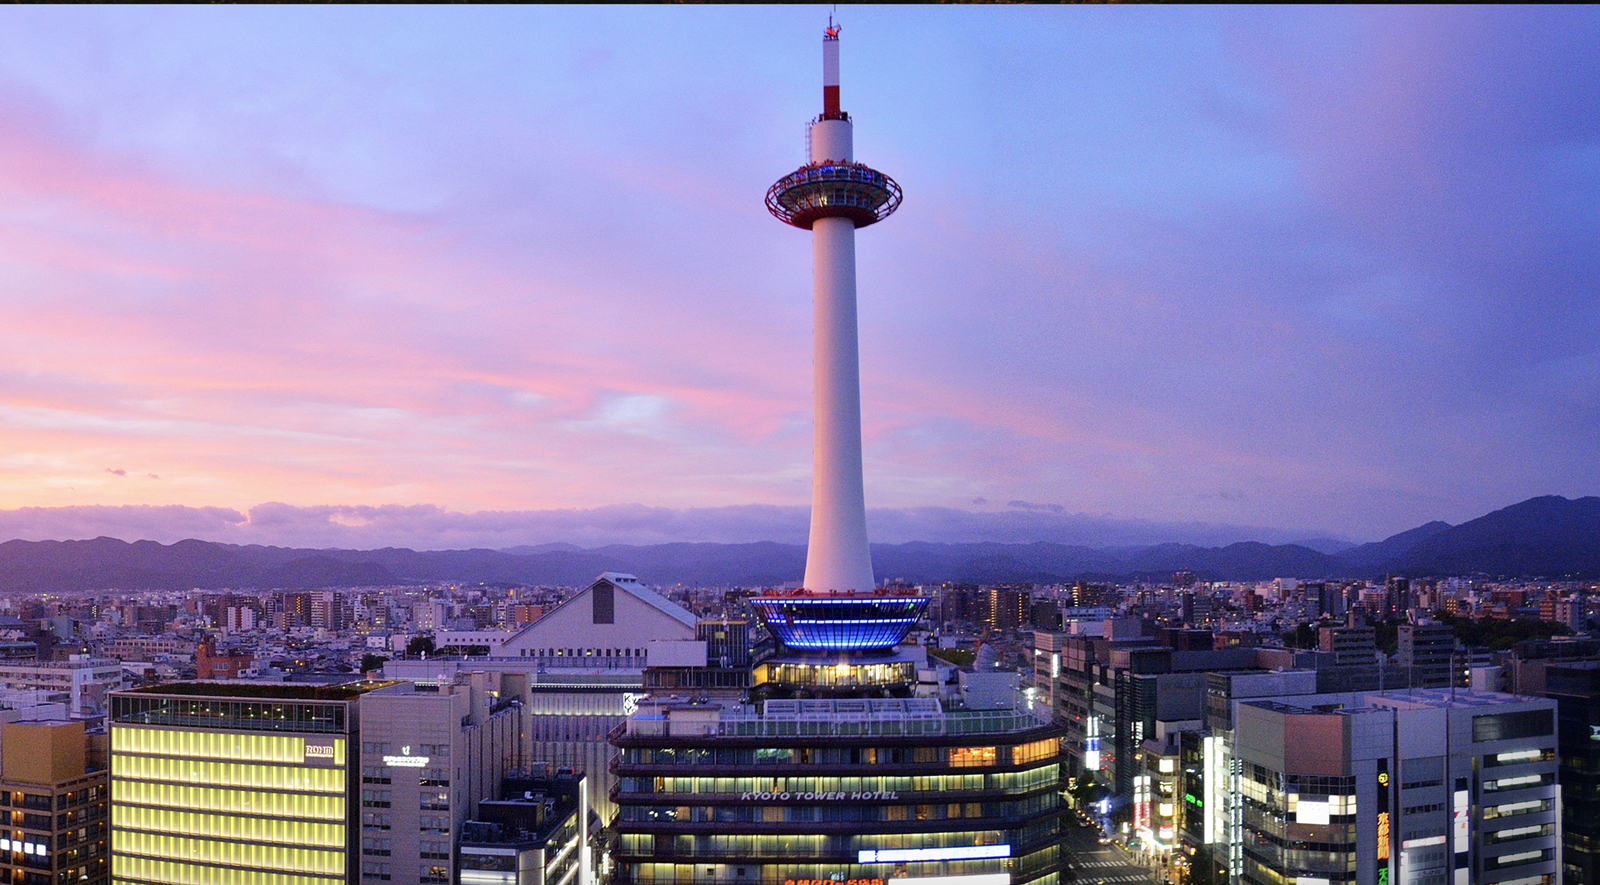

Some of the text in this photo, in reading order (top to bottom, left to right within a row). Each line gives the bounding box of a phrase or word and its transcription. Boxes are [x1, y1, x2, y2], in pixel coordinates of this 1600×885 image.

[305, 745, 334, 755] ROHM
[741, 791, 899, 801] KYOTO TOWER HOTEL
